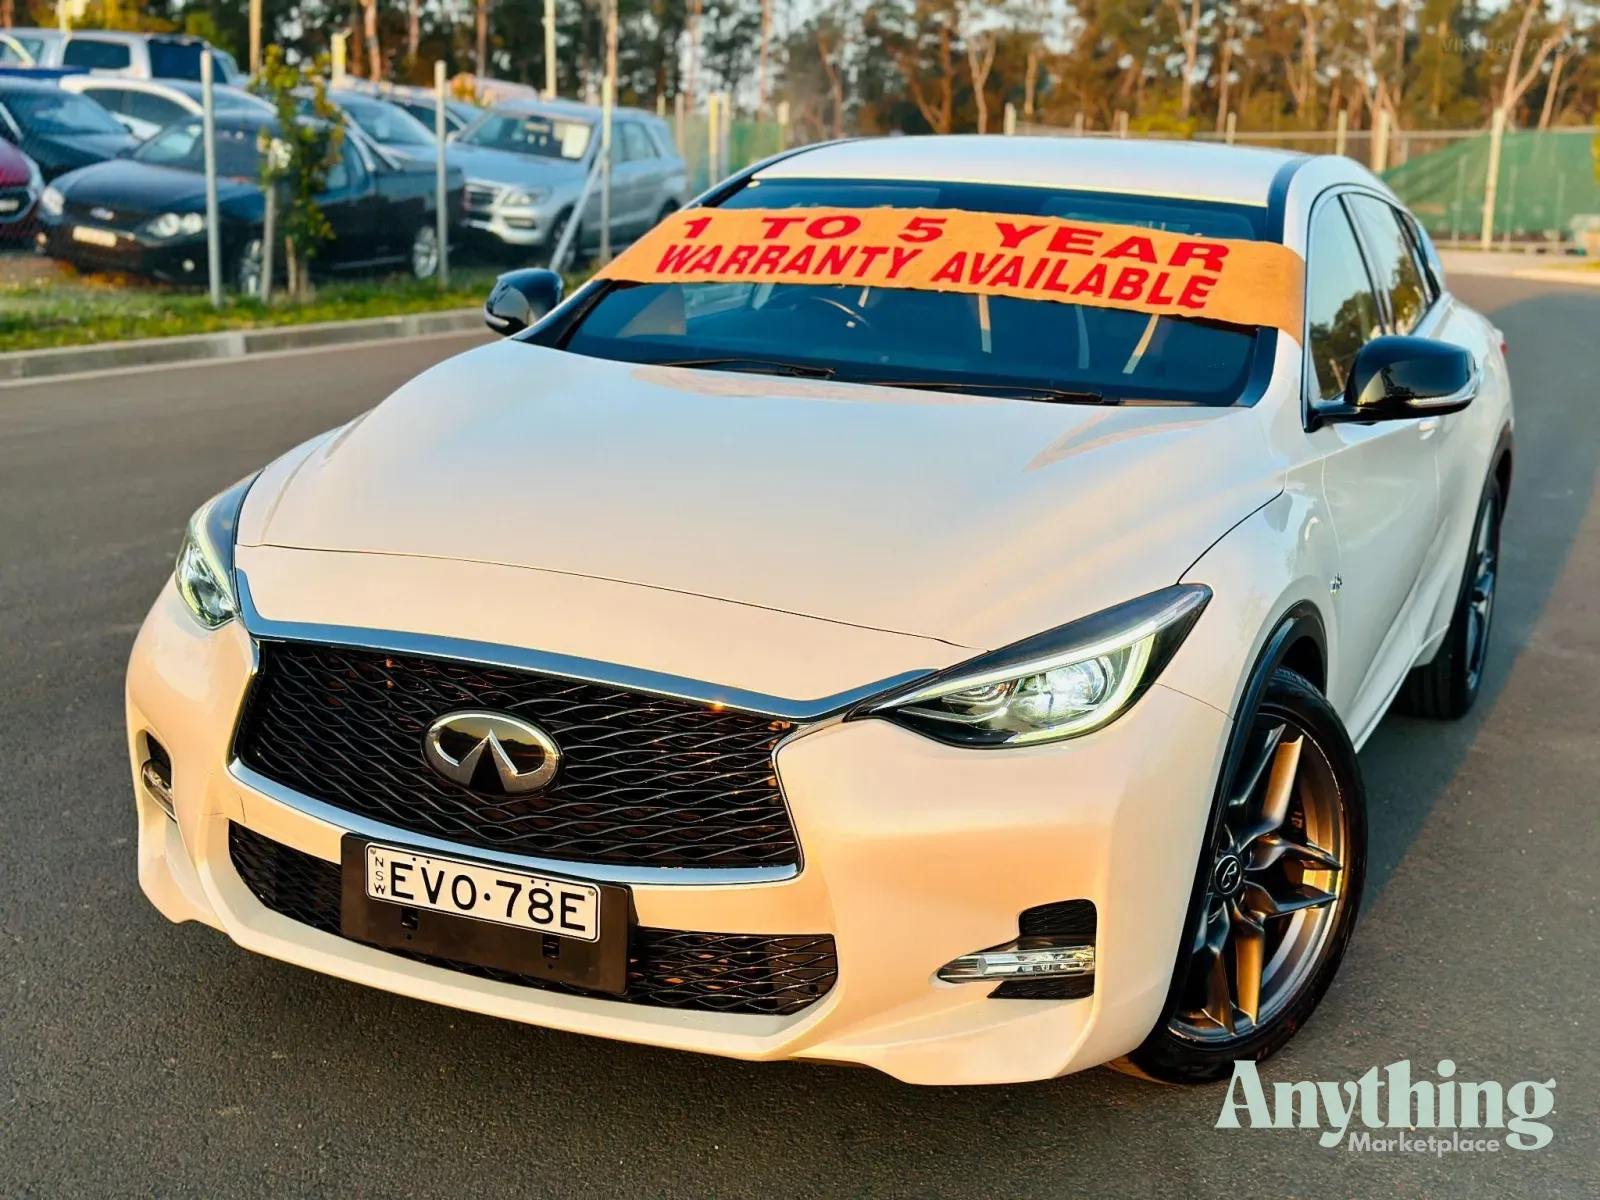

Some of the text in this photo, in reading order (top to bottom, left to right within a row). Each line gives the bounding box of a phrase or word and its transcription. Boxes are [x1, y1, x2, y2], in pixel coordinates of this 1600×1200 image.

[682, 215, 1230, 273] 1 TO 5 YEAR
[655, 244, 1219, 310] WARRANTY AVAILABLE
